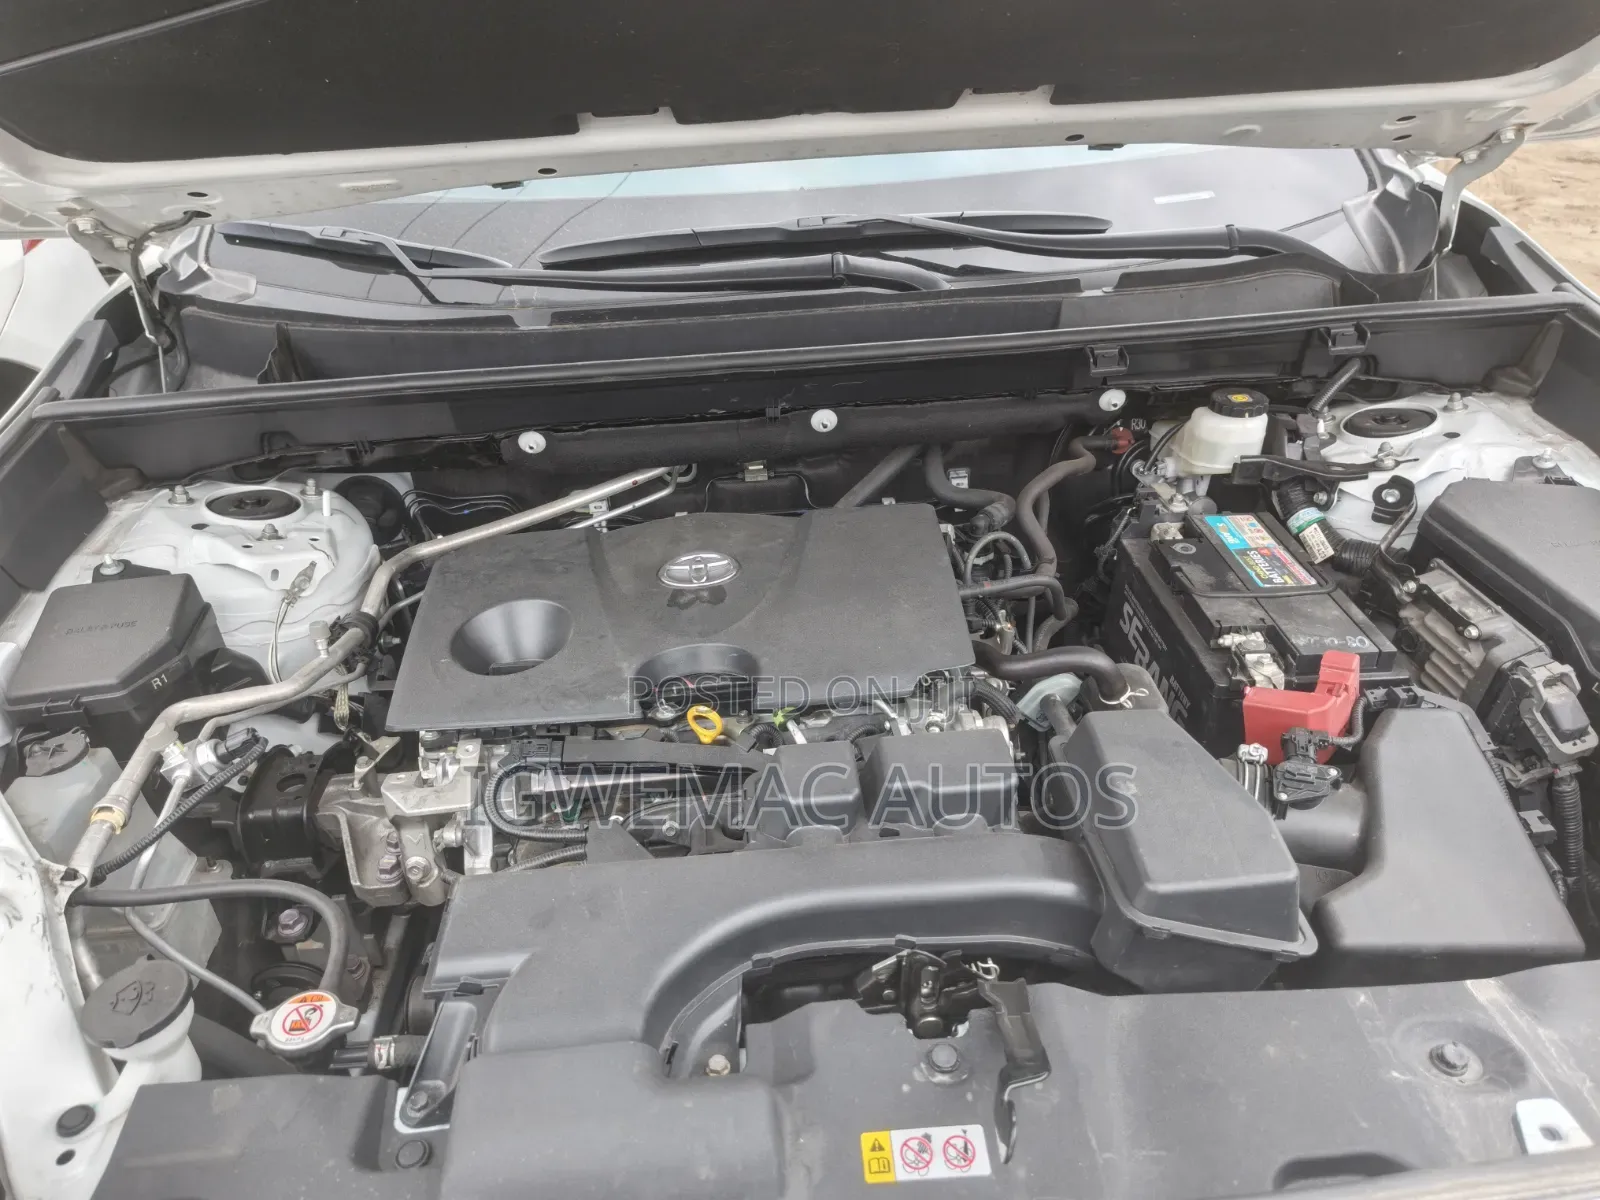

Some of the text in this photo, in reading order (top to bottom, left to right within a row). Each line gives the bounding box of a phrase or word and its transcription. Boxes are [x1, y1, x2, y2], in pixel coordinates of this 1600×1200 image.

[1247, 550, 1285, 583] BATTERIES
[151, 673, 168, 690] R1
[1168, 673, 1192, 710] BATTERY
